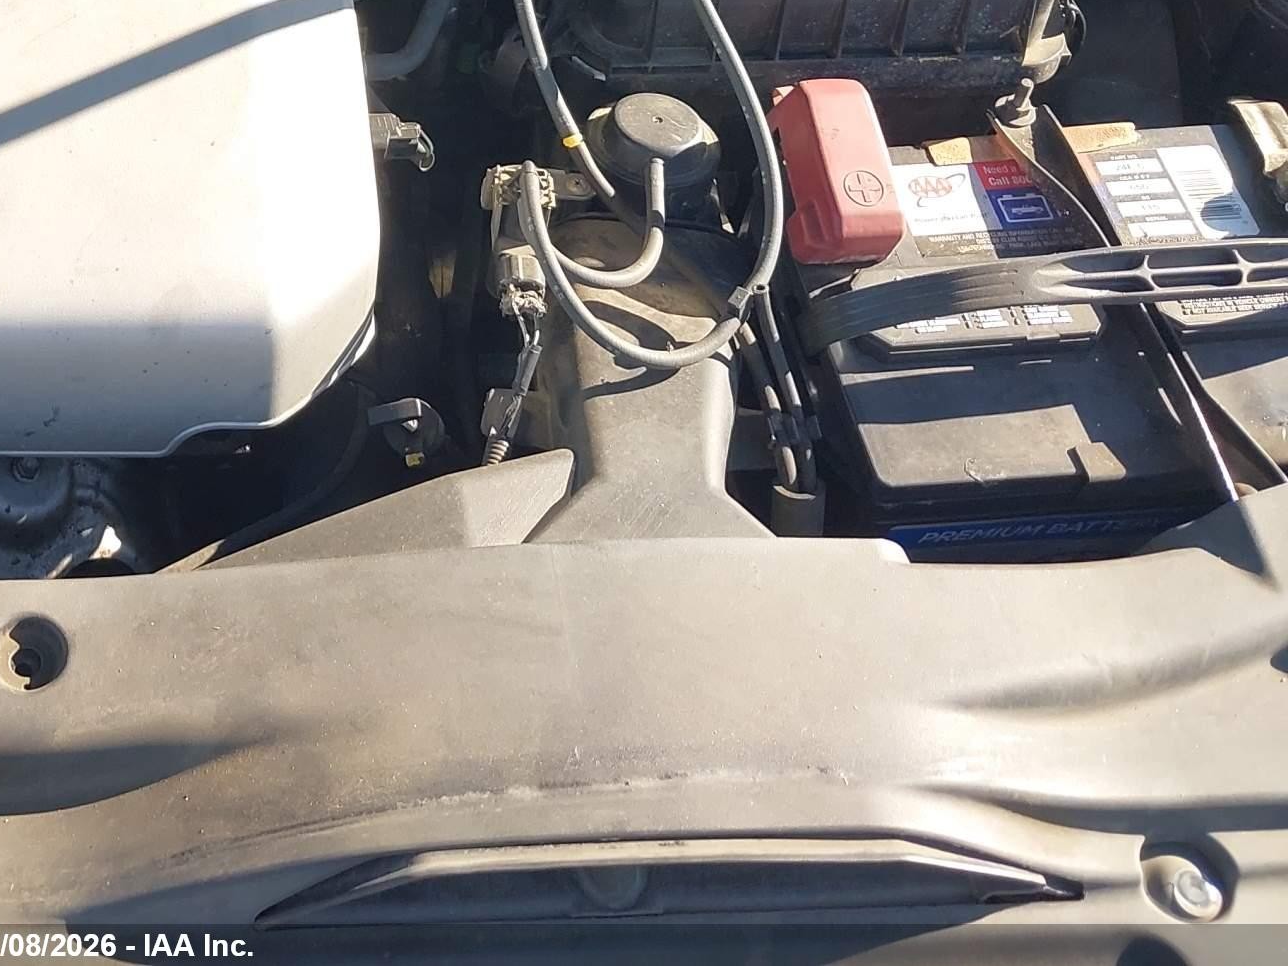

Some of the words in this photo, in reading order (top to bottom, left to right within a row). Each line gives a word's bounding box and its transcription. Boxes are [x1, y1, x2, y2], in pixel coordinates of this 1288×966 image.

[983, 165, 1009, 175] Need
[910, 176, 950, 198] AAA
[988, 176, 1010, 186] Call
[918, 524, 1046, 544] PREMIUM
